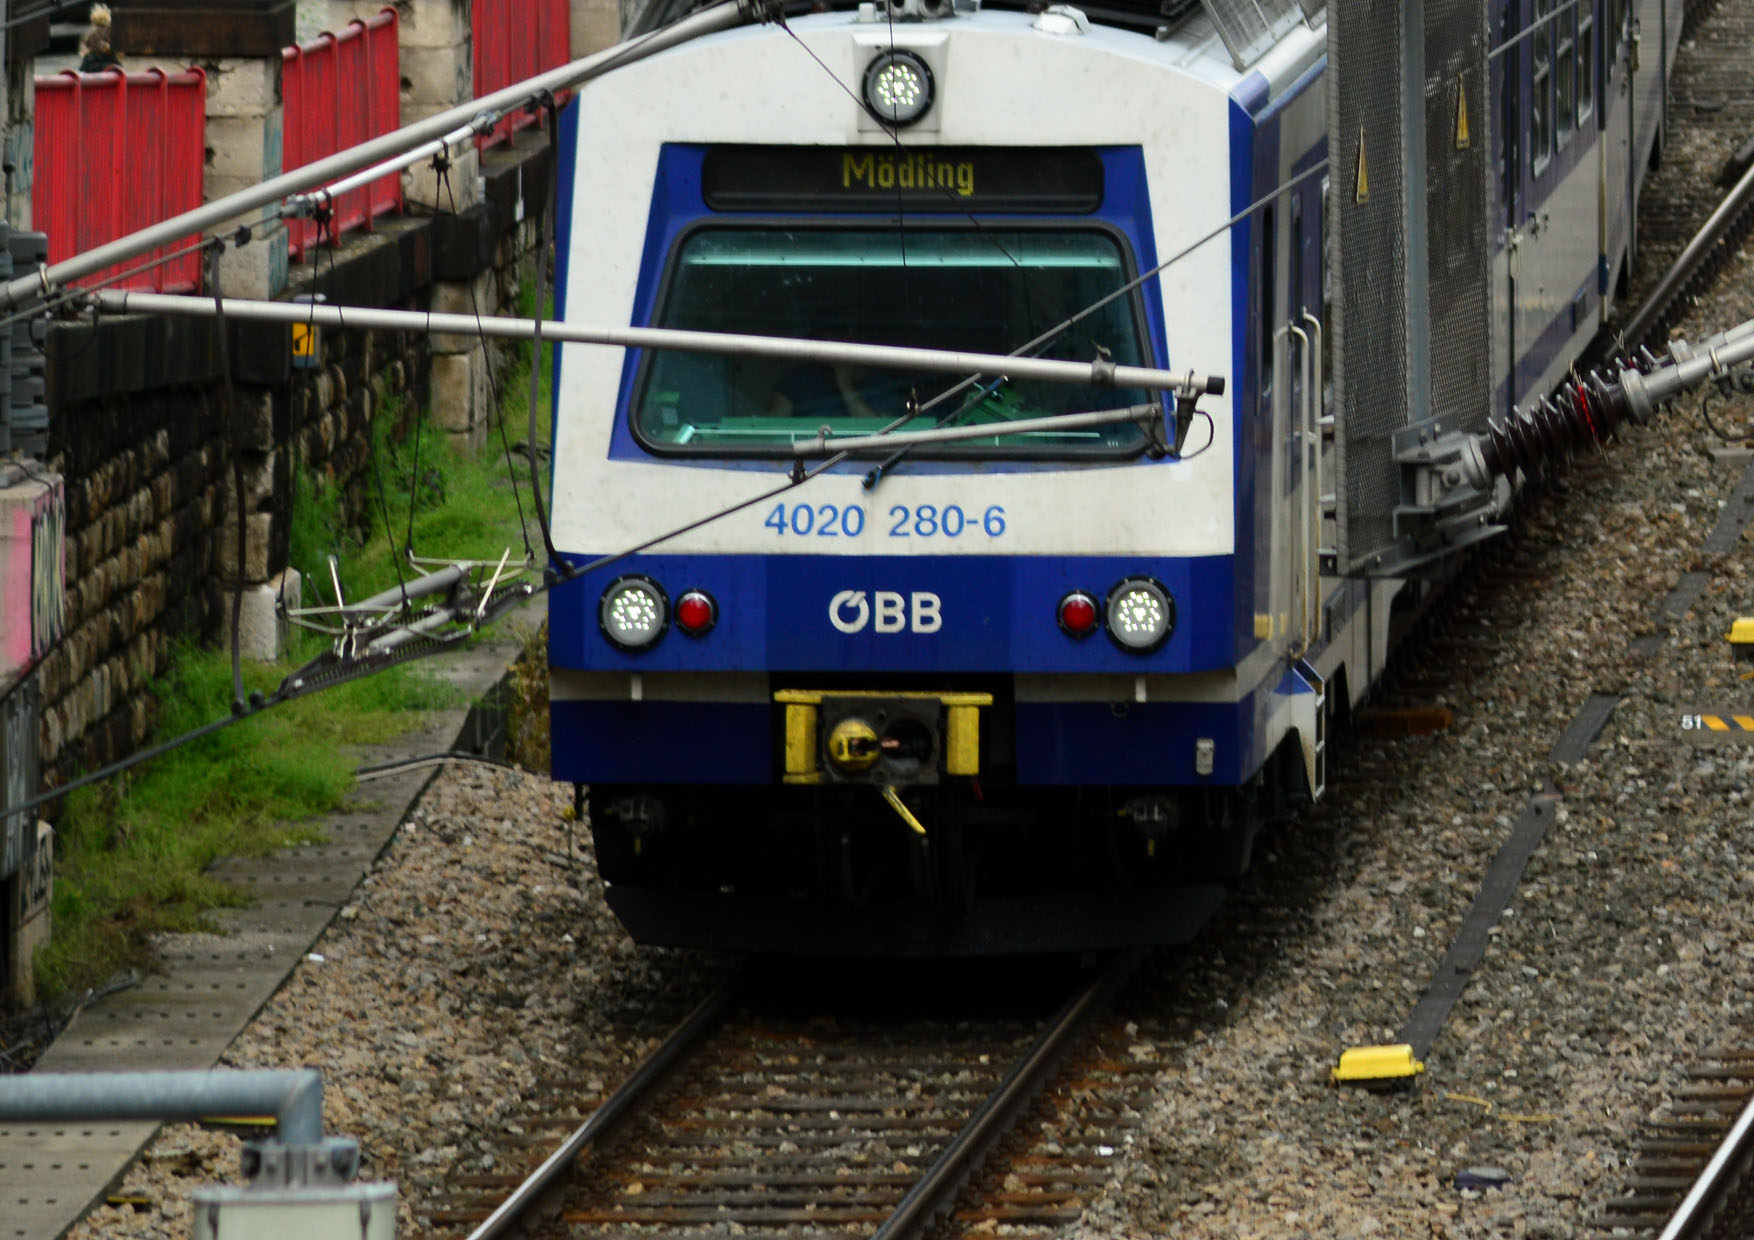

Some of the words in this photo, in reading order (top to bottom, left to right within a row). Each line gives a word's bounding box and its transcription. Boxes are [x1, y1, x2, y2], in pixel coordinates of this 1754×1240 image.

[842, 153, 975, 197] Mödling
[764, 503, 866, 539] 4020
[888, 504, 1007, 538] 280-6
[828, 589, 943, 634] ÖBB
[1682, 713, 1702, 730] 51
